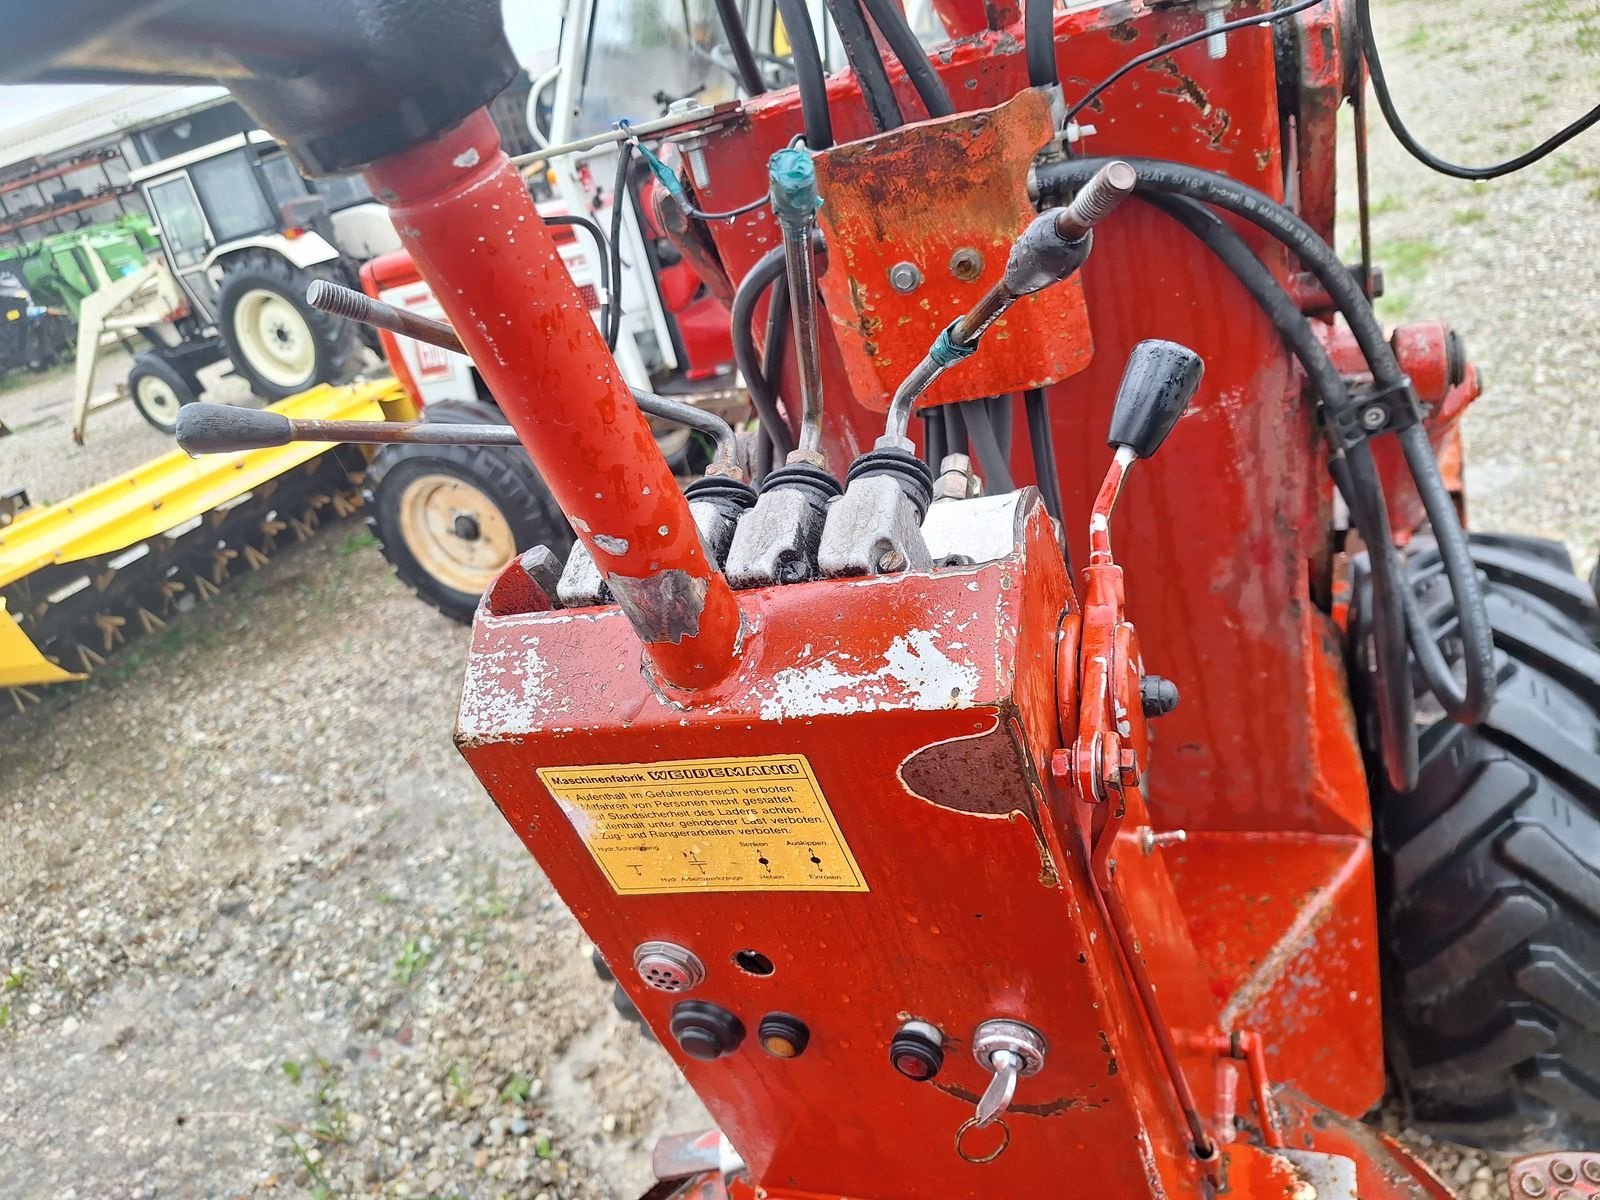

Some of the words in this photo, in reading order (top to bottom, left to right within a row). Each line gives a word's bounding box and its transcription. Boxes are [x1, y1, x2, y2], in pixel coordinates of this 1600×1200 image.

[551, 773, 646, 785] Maschinenfabrik
[647, 763, 800, 781] WEIDEMANN
[576, 790, 628, 801] Aufenthalt
[630, 791, 643, 799] im
[645, 786, 739, 799] Gefahrenbereich
[742, 785, 798, 795] verboten.
[632, 801, 653, 810] von
[655, 798, 709, 808] Personen
[710, 797, 742, 806] nicht
[743, 795, 797, 806] gestattet.
[607, 809, 691, 821] Standsicherheit
[693, 809, 715, 817] des
[718, 807, 759, 817] Laders
[762, 805, 805, 815] achten.
[648, 820, 675, 829] unter
[679, 817, 738, 829] gehobener
[742, 815, 768, 825] Last
[768, 814, 826, 825] verboten.
[602, 832, 625, 840] Zug-
[627, 829, 647, 839] und
[649, 826, 736, 839] Rangierarbeiten
[738, 825, 792, 837] verboten.
[786, 840, 827, 848] Auskippen
